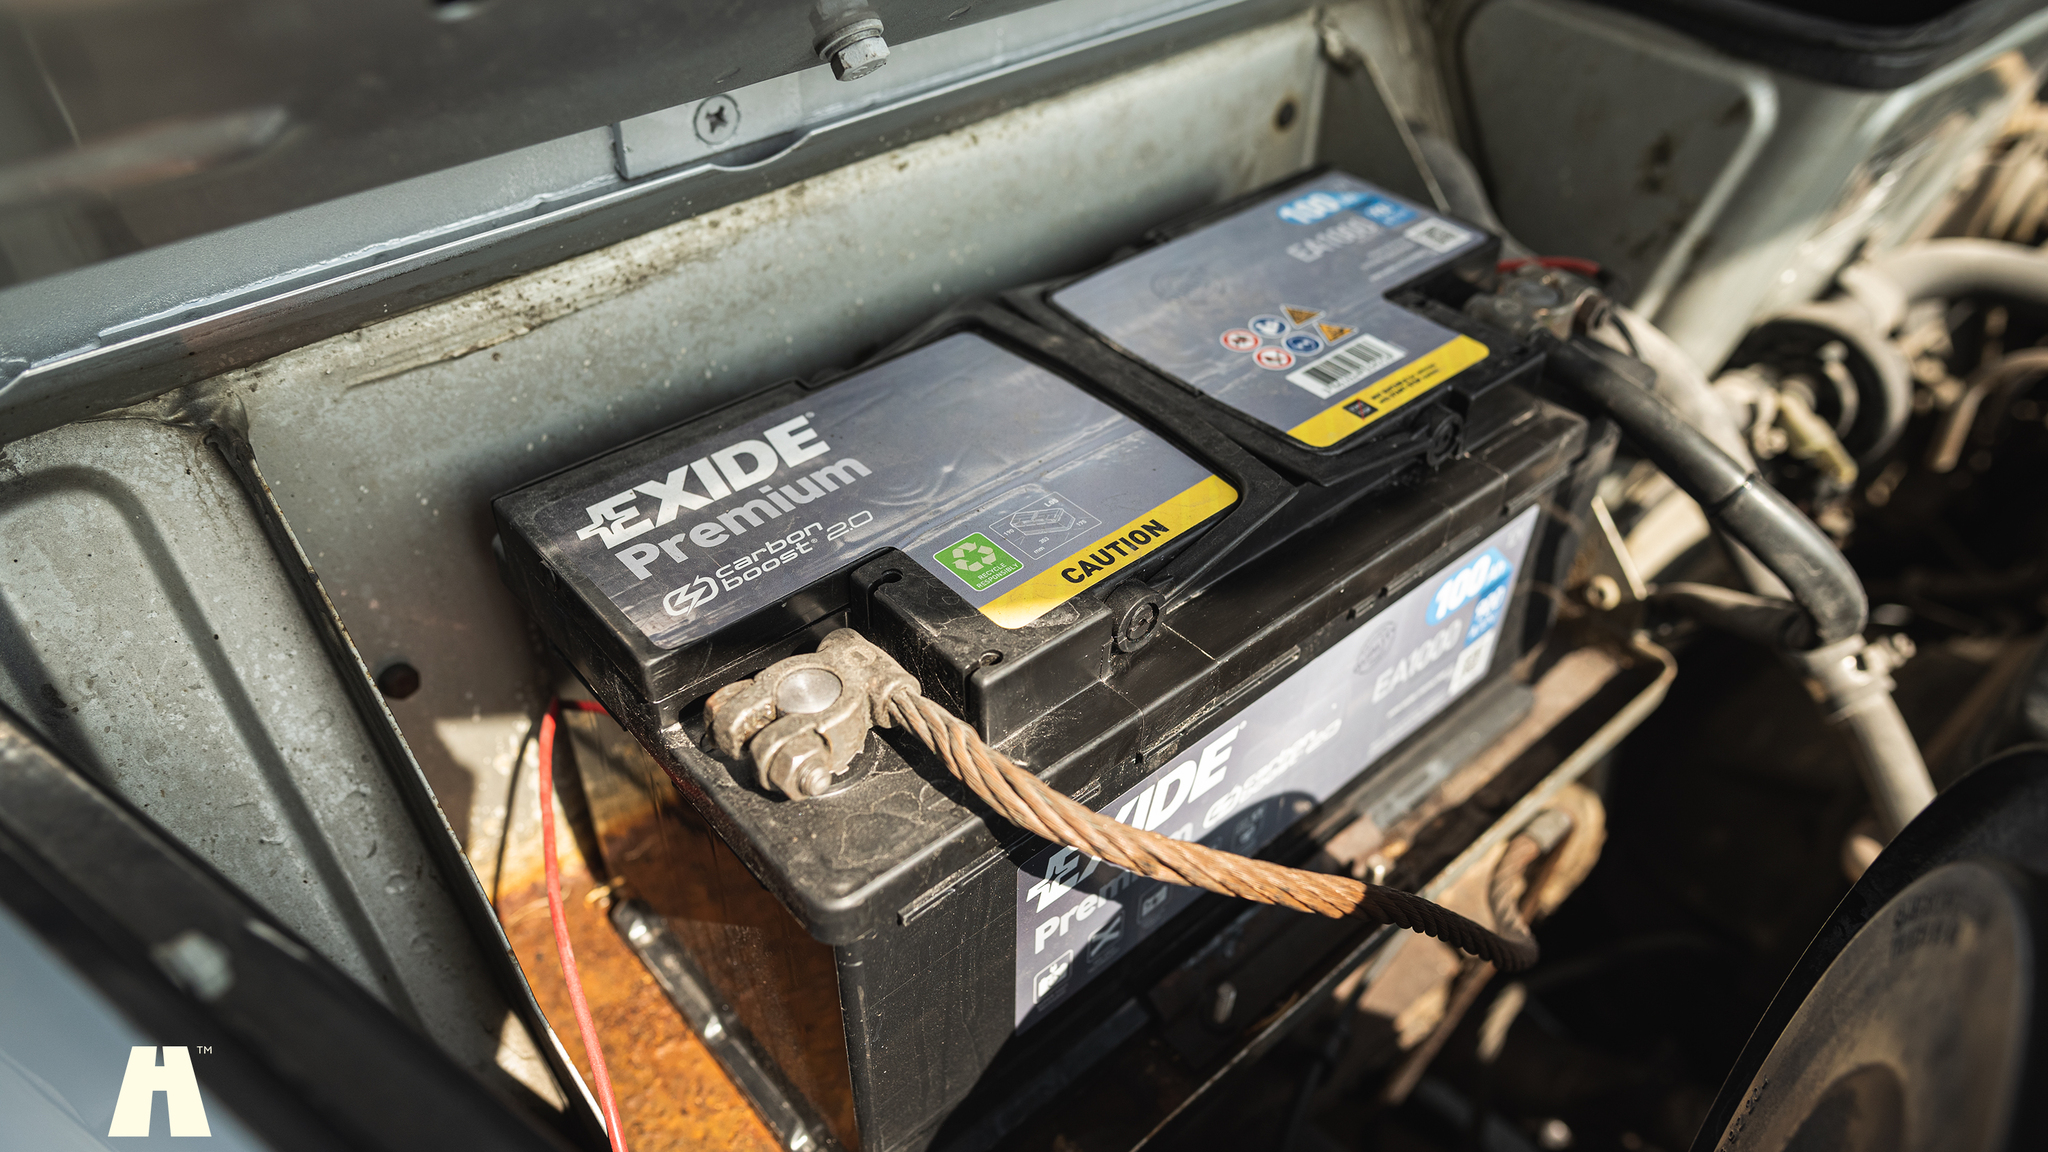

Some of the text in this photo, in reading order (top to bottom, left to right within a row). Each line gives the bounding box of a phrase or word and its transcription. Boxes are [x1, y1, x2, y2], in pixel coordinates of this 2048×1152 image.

[615, 457, 873, 581] Premium
[715, 521, 824, 579] carbon
[826, 510, 874, 542] 2.0
[976, 562, 1019, 589] RESPONSIBLY
[977, 562, 1007, 581] RECYCLE
[1060, 518, 1170, 584] CAUTION
[1435, 553, 1492, 621] 100
[1372, 618, 1463, 704] EA1000
